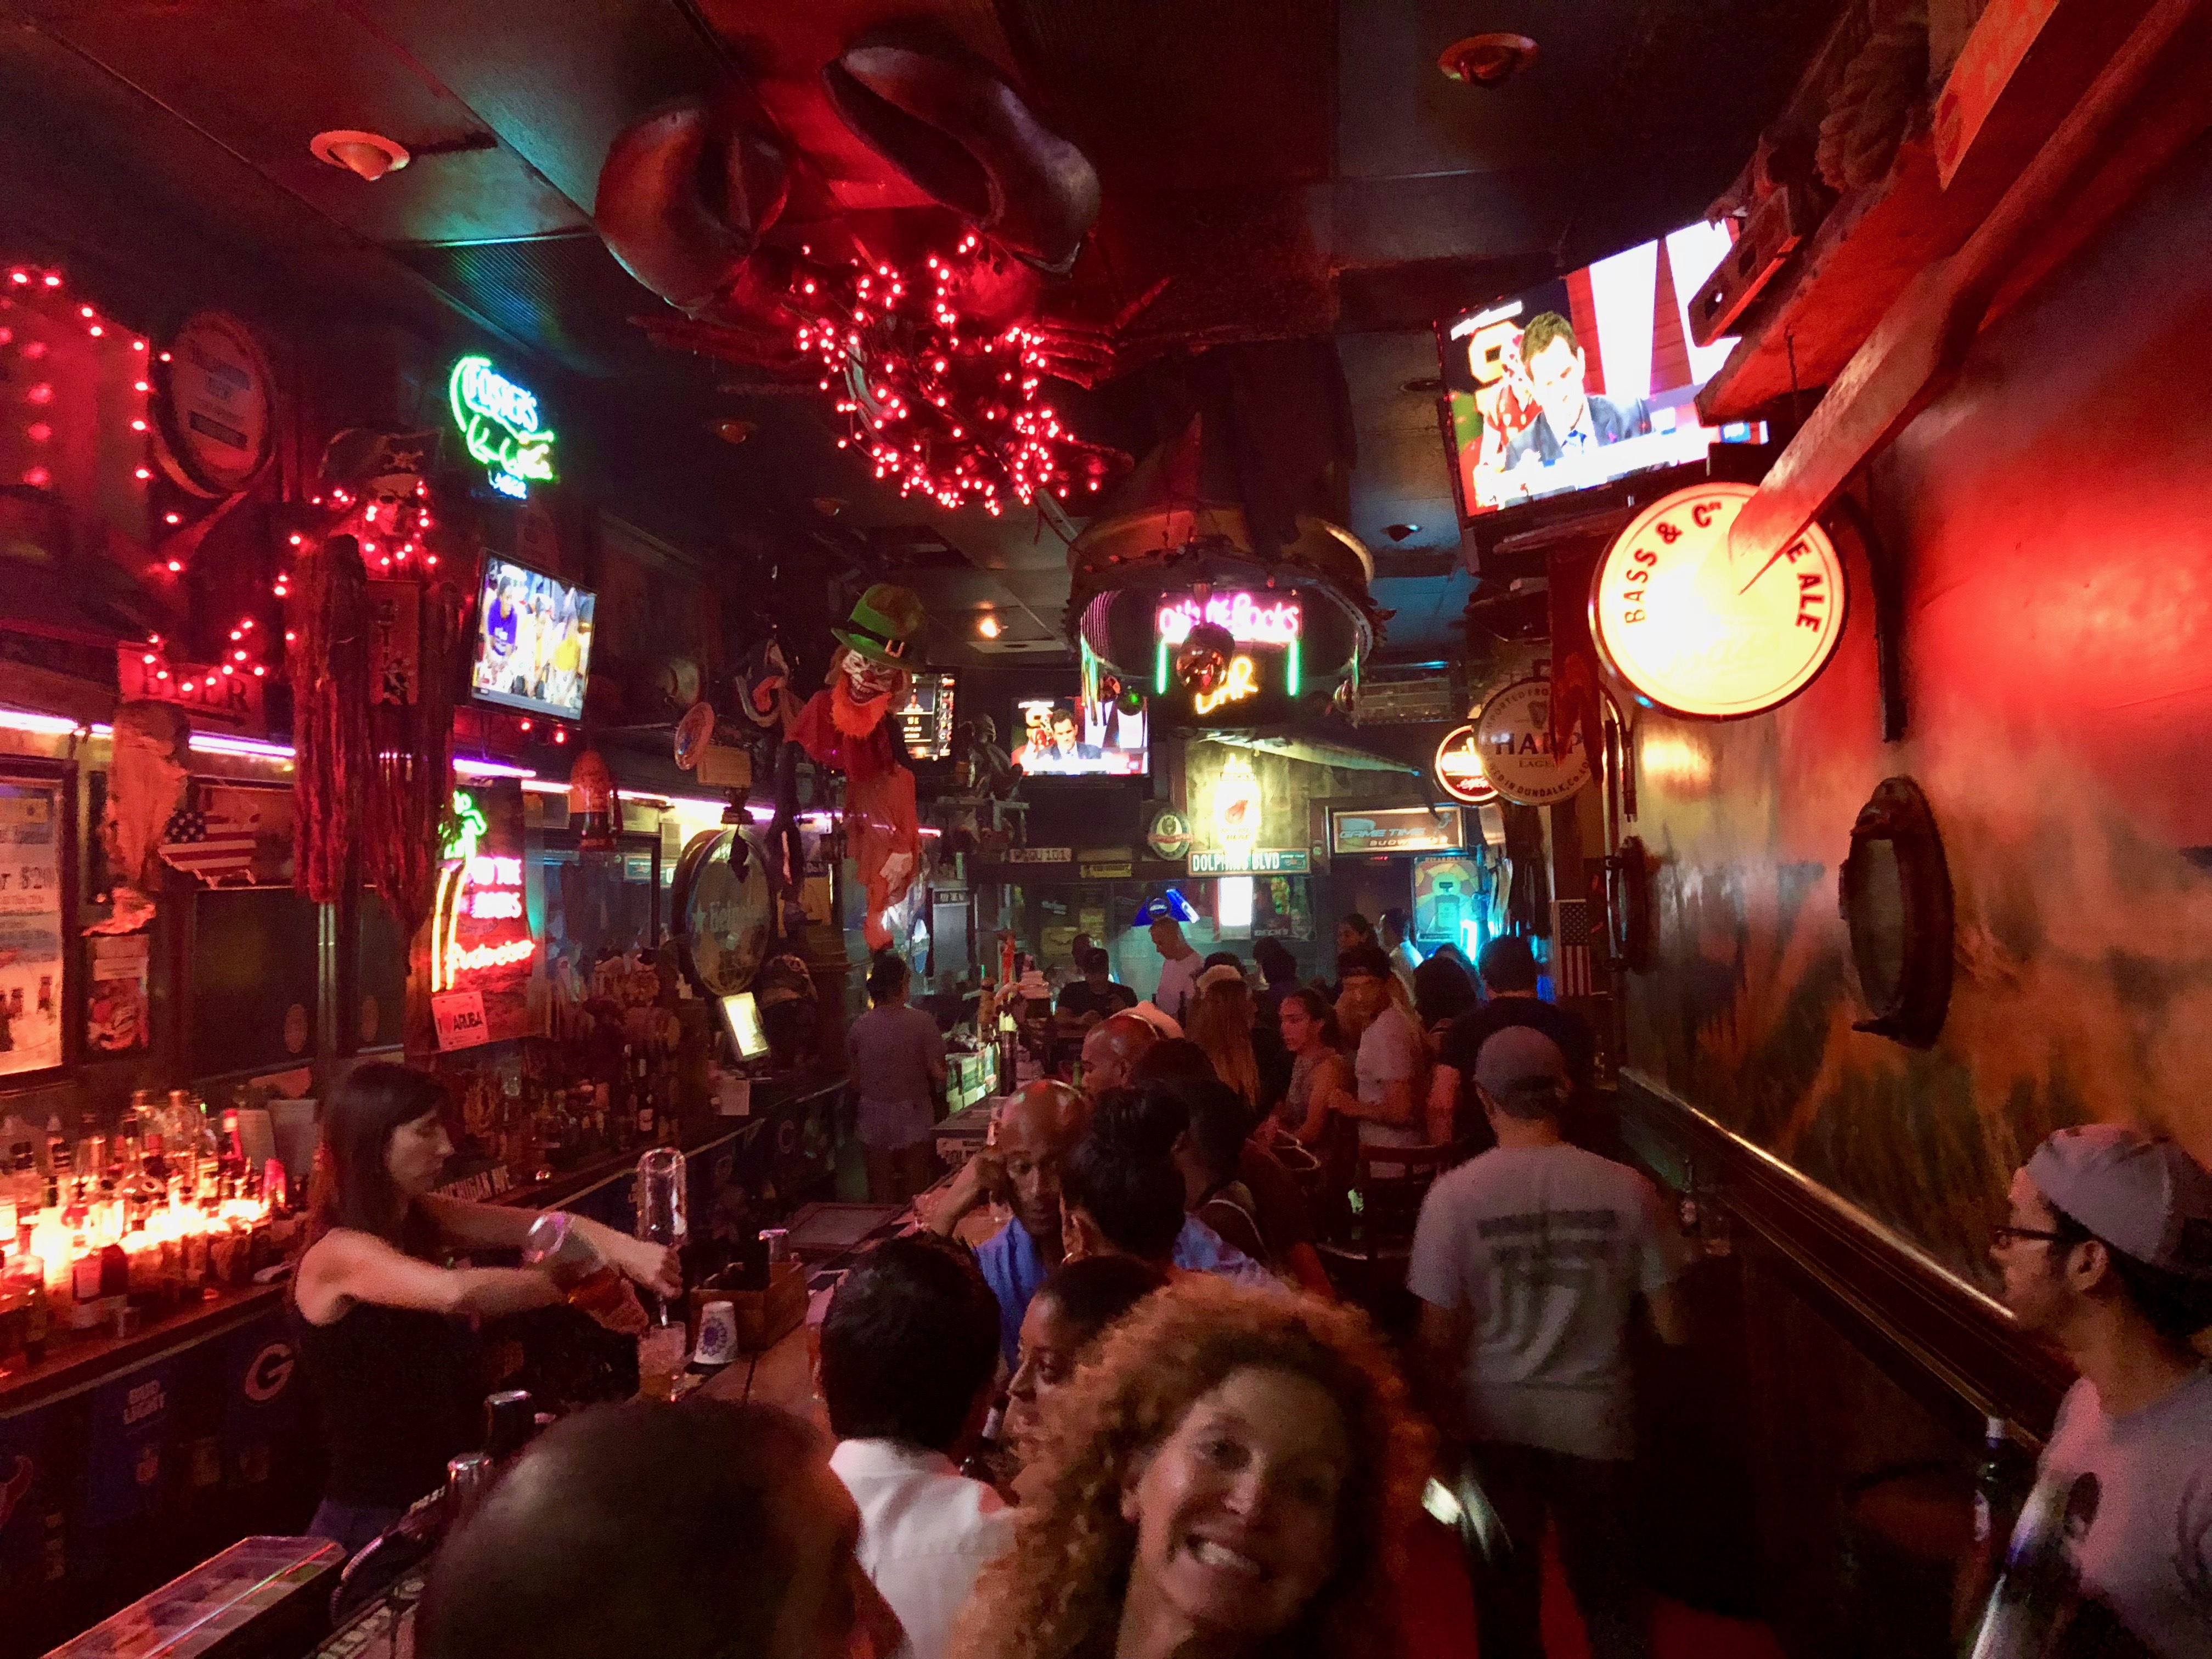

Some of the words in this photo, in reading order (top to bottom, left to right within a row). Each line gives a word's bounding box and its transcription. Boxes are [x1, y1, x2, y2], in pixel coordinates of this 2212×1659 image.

[1623, 548, 1658, 624] BASS
[1655, 521, 1683, 545] &
[1795, 573, 1825, 633] ALE
[1527, 687, 1549, 697] FRO
[1519, 760, 1556, 769] LAGE
[1339, 828, 1386, 839] GAME
[1389, 827, 1426, 837] TIME
[1251, 852, 1280, 870] BLVD
[454, 1011, 483, 1031] ARUBA
